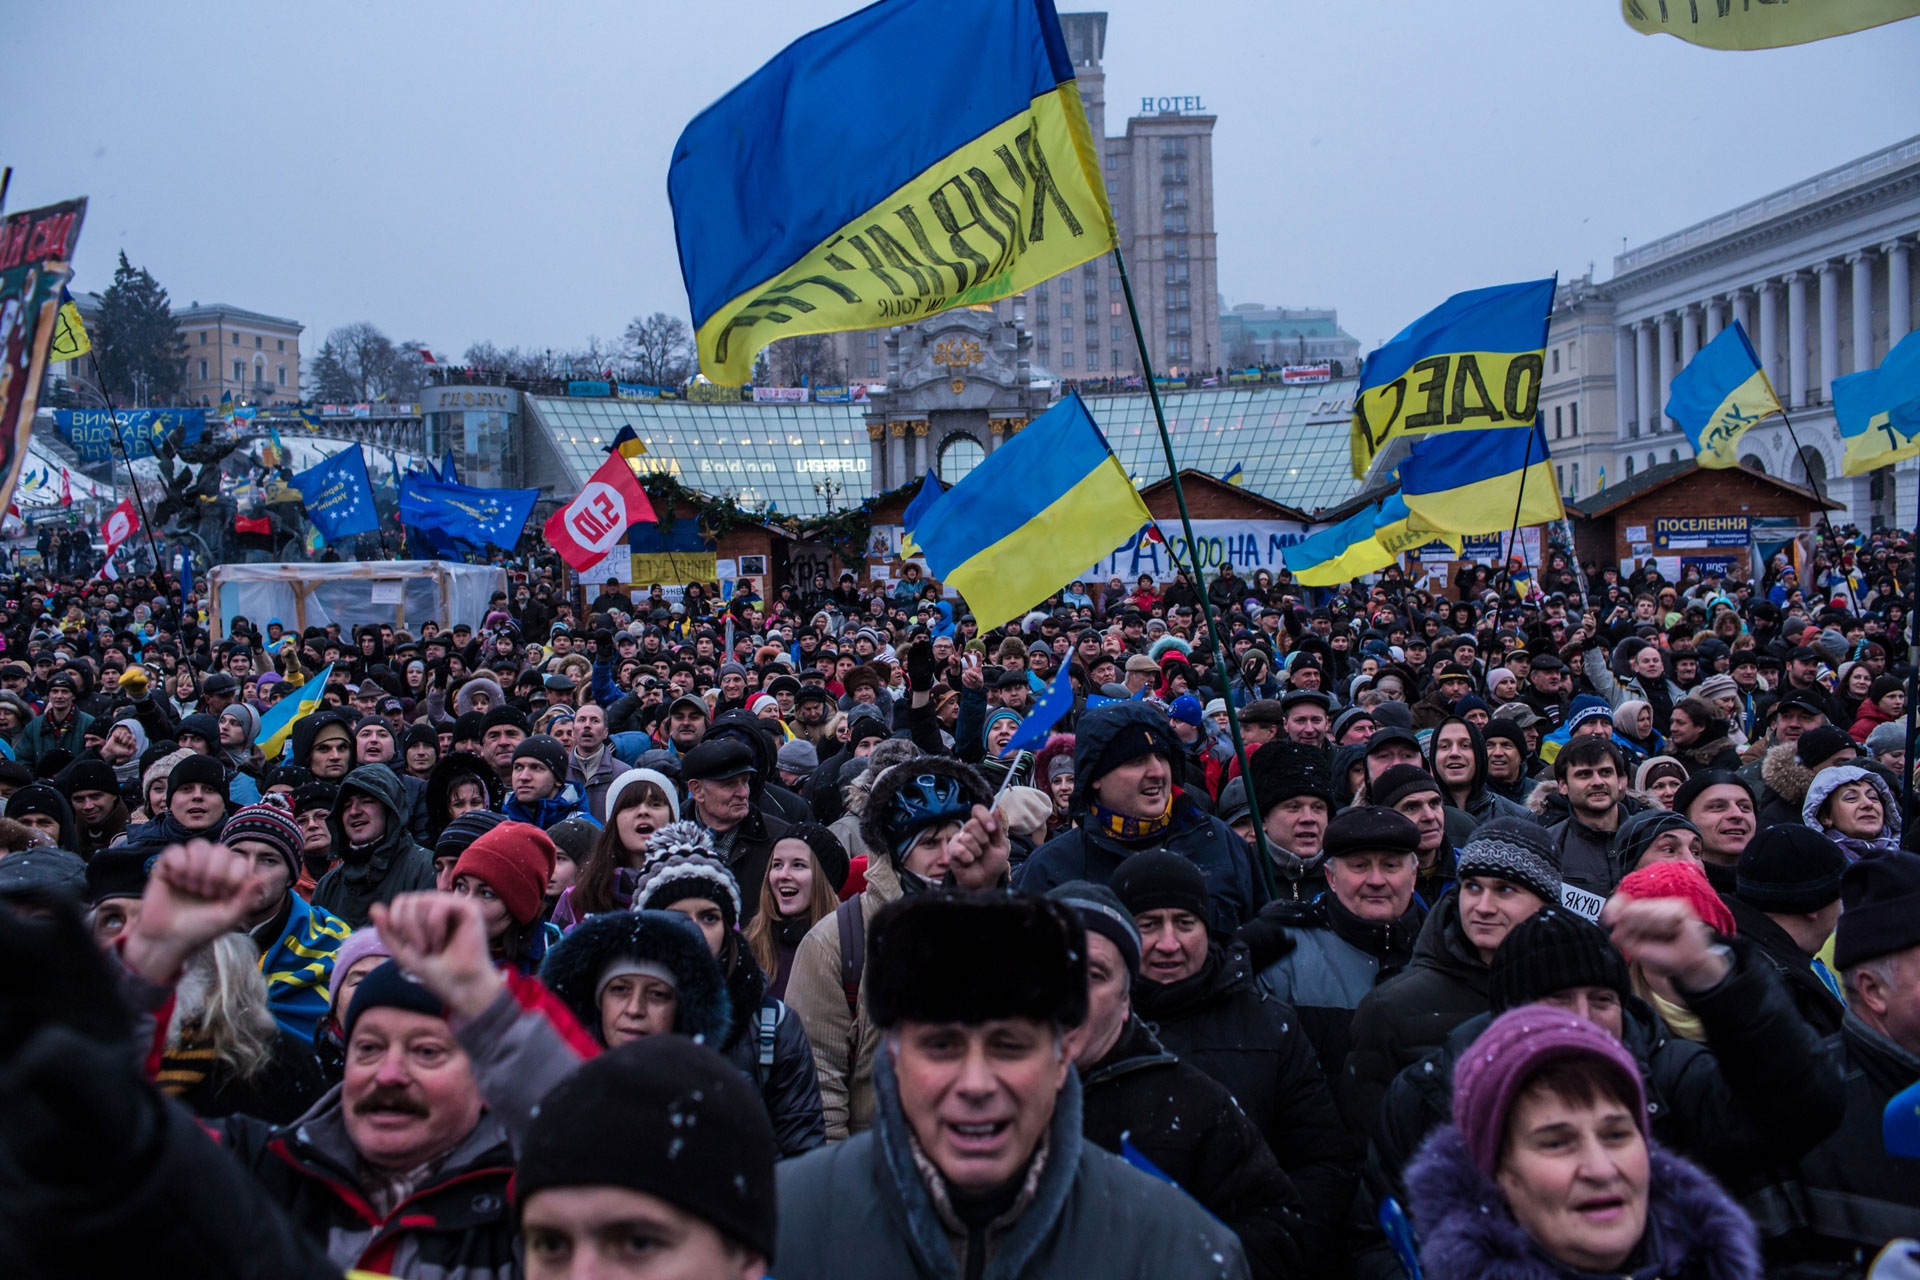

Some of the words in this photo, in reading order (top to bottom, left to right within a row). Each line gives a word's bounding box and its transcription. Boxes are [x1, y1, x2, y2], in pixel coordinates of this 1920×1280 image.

[1141, 95, 1206, 112] HOTEL
[439, 391, 508, 408] ГЛОБУС
[72, 410, 151, 426] ВИМОГА
[700, 458, 776, 473] Baldinini
[796, 458, 867, 473] LAGERFELD
[1657, 517, 1748, 533] ПОСЕЛЕННЯ
[1228, 533, 1260, 567] НА
